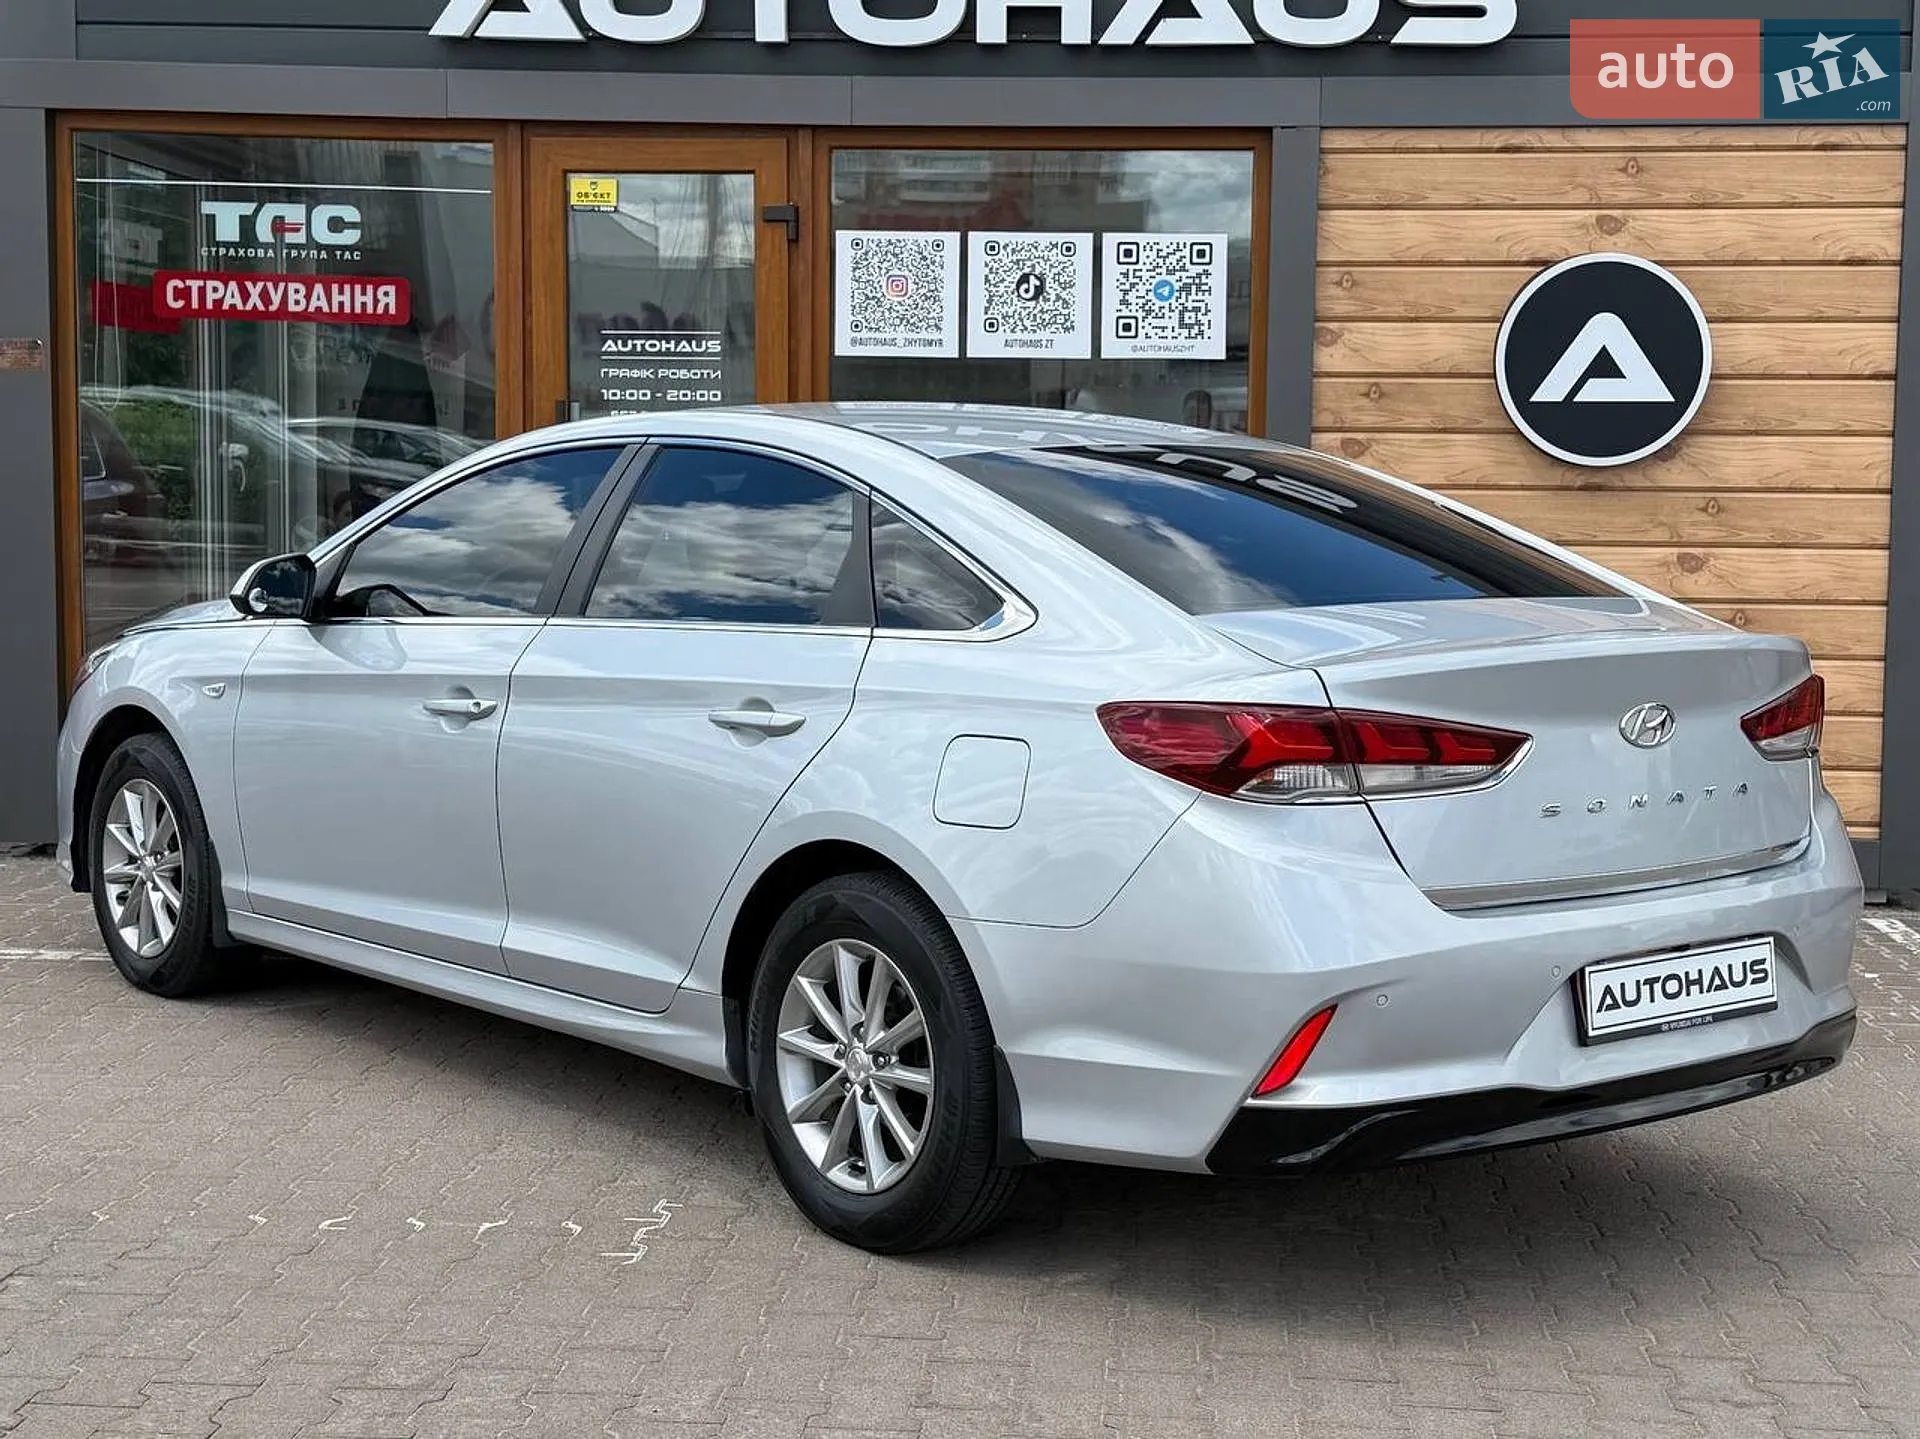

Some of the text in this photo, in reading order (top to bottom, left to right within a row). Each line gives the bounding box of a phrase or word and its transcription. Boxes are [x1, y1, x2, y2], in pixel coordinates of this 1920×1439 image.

[201, 247, 361, 261] СТРАХОВА ГРУПА ТАС
[166, 278, 396, 315] СТРАХУВАННЯ
[601, 339, 721, 353] AUTOHAUS
[1004, 339, 1043, 349] AUTOHAUS
[600, 368, 722, 380] ГРАФІК РОБОТИ
[601, 389, 651, 401] 10:00
[666, 389, 722, 401] 20:00
[1540, 782, 1749, 818] SONATA
[1596, 957, 1769, 1014] AUTOHAUS
